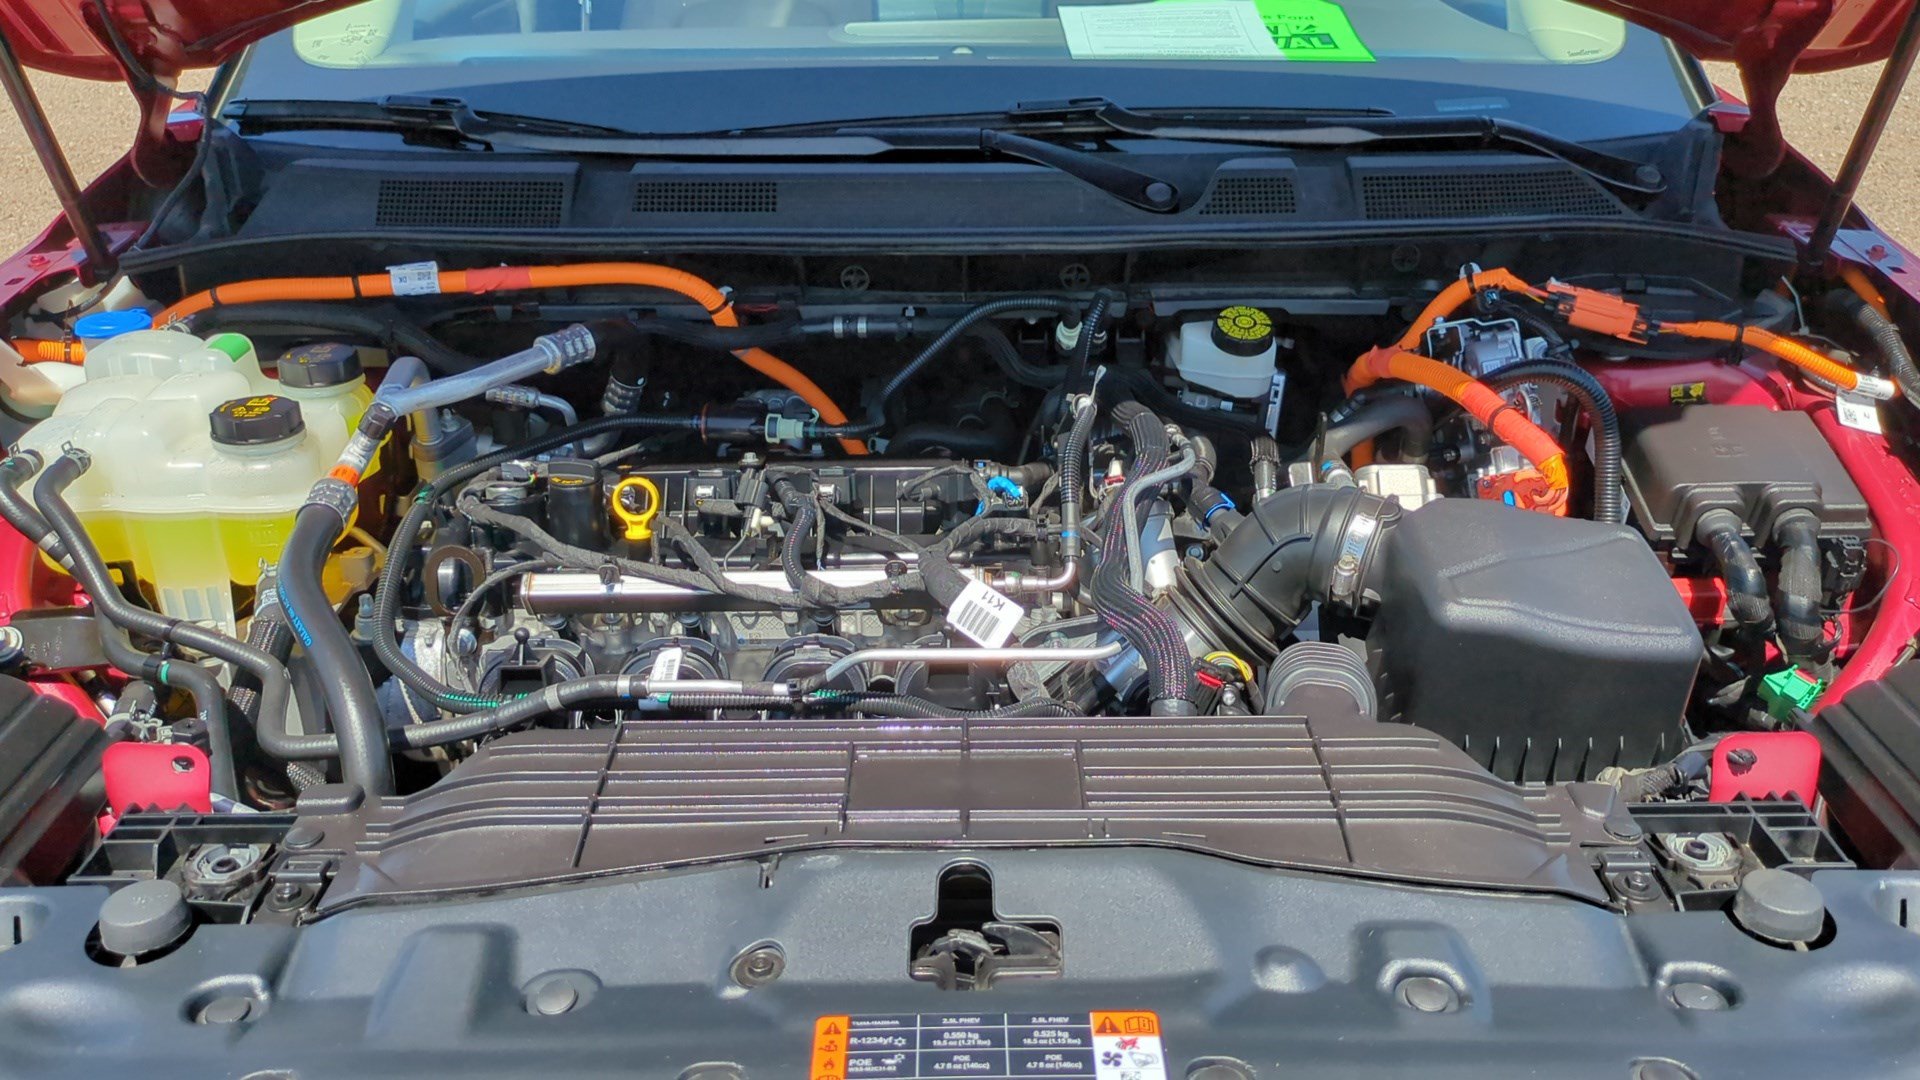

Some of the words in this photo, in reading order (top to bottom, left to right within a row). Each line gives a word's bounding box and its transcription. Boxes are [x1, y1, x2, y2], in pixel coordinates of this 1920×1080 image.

[981, 590, 1006, 612] K11
[293, 616, 312, 647] GALAXY
[968, 1031, 979, 1040] kg
[1033, 1030, 1056, 1038] 0.525
[1057, 1030, 1069, 1038] kg
[849, 1036, 894, 1045] R-1234yf
[848, 1058, 873, 1067] POE
